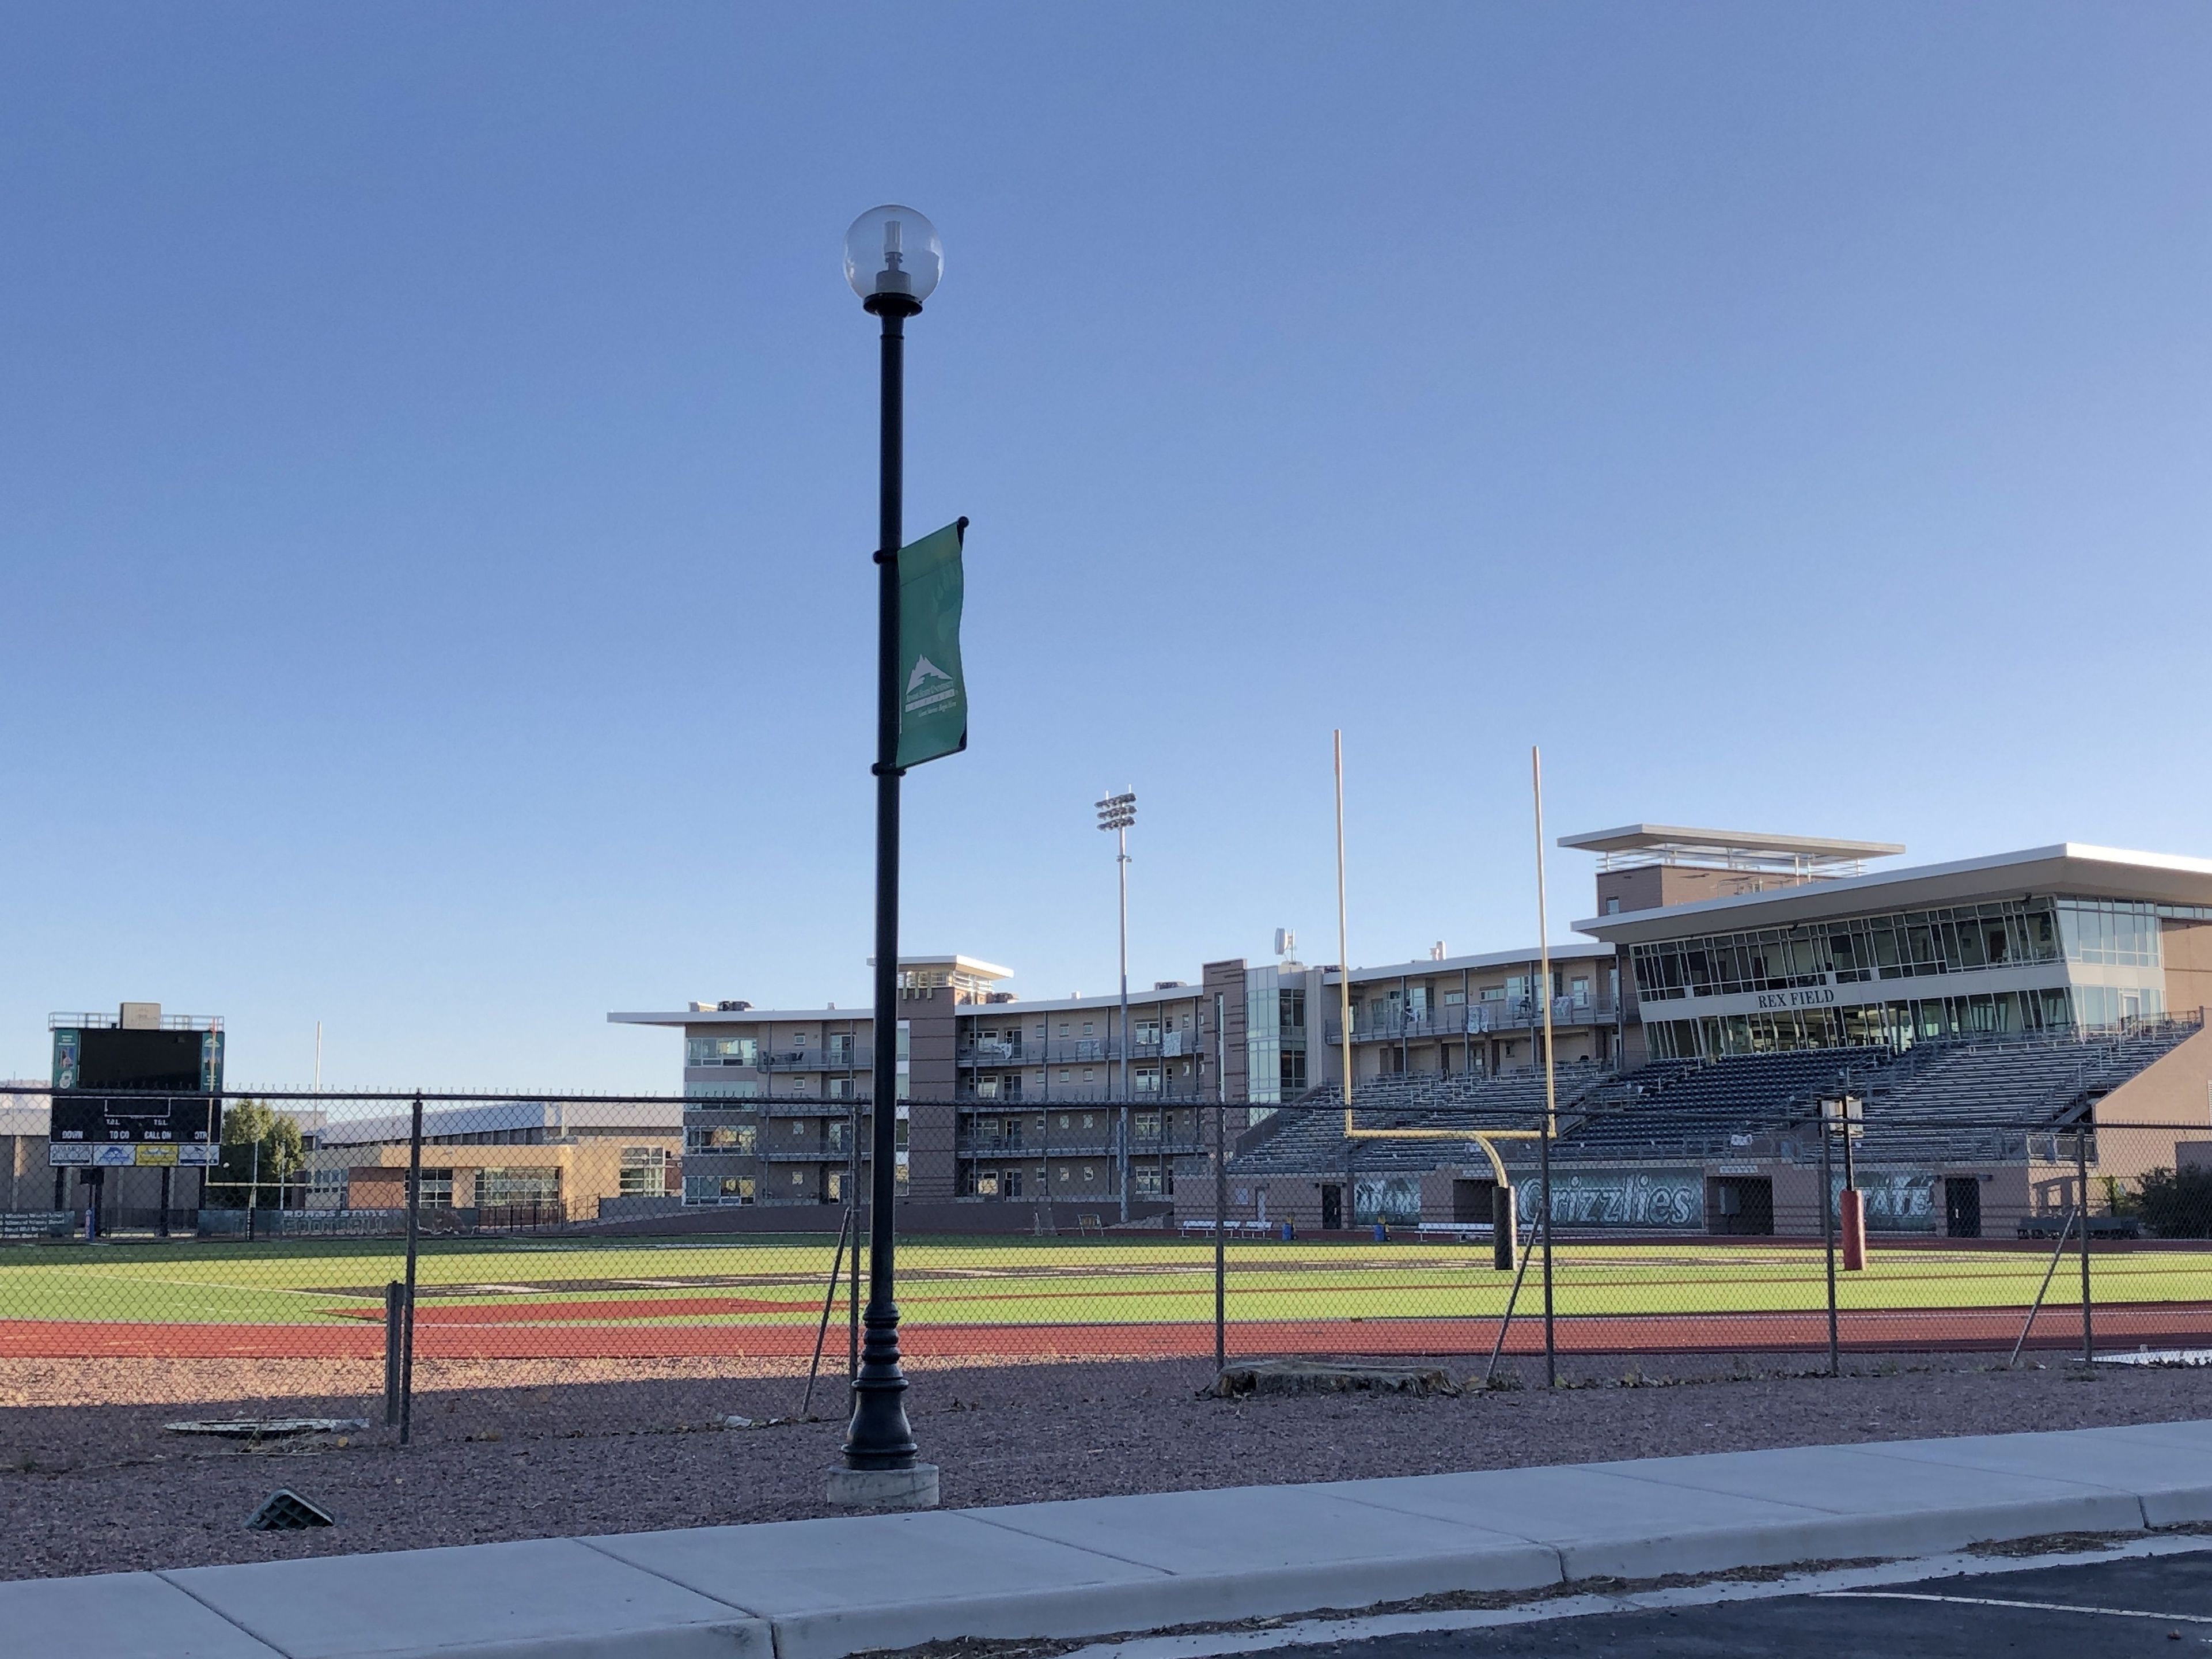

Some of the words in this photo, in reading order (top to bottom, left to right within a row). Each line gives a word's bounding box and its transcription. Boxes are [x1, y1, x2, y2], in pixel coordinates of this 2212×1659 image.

[1758, 993, 1787, 1008] REX
[1790, 989, 1834, 1006] FIELD
[62, 1130, 84, 1139] DOWN
[1517, 1175, 1694, 1225] Grizzlies
